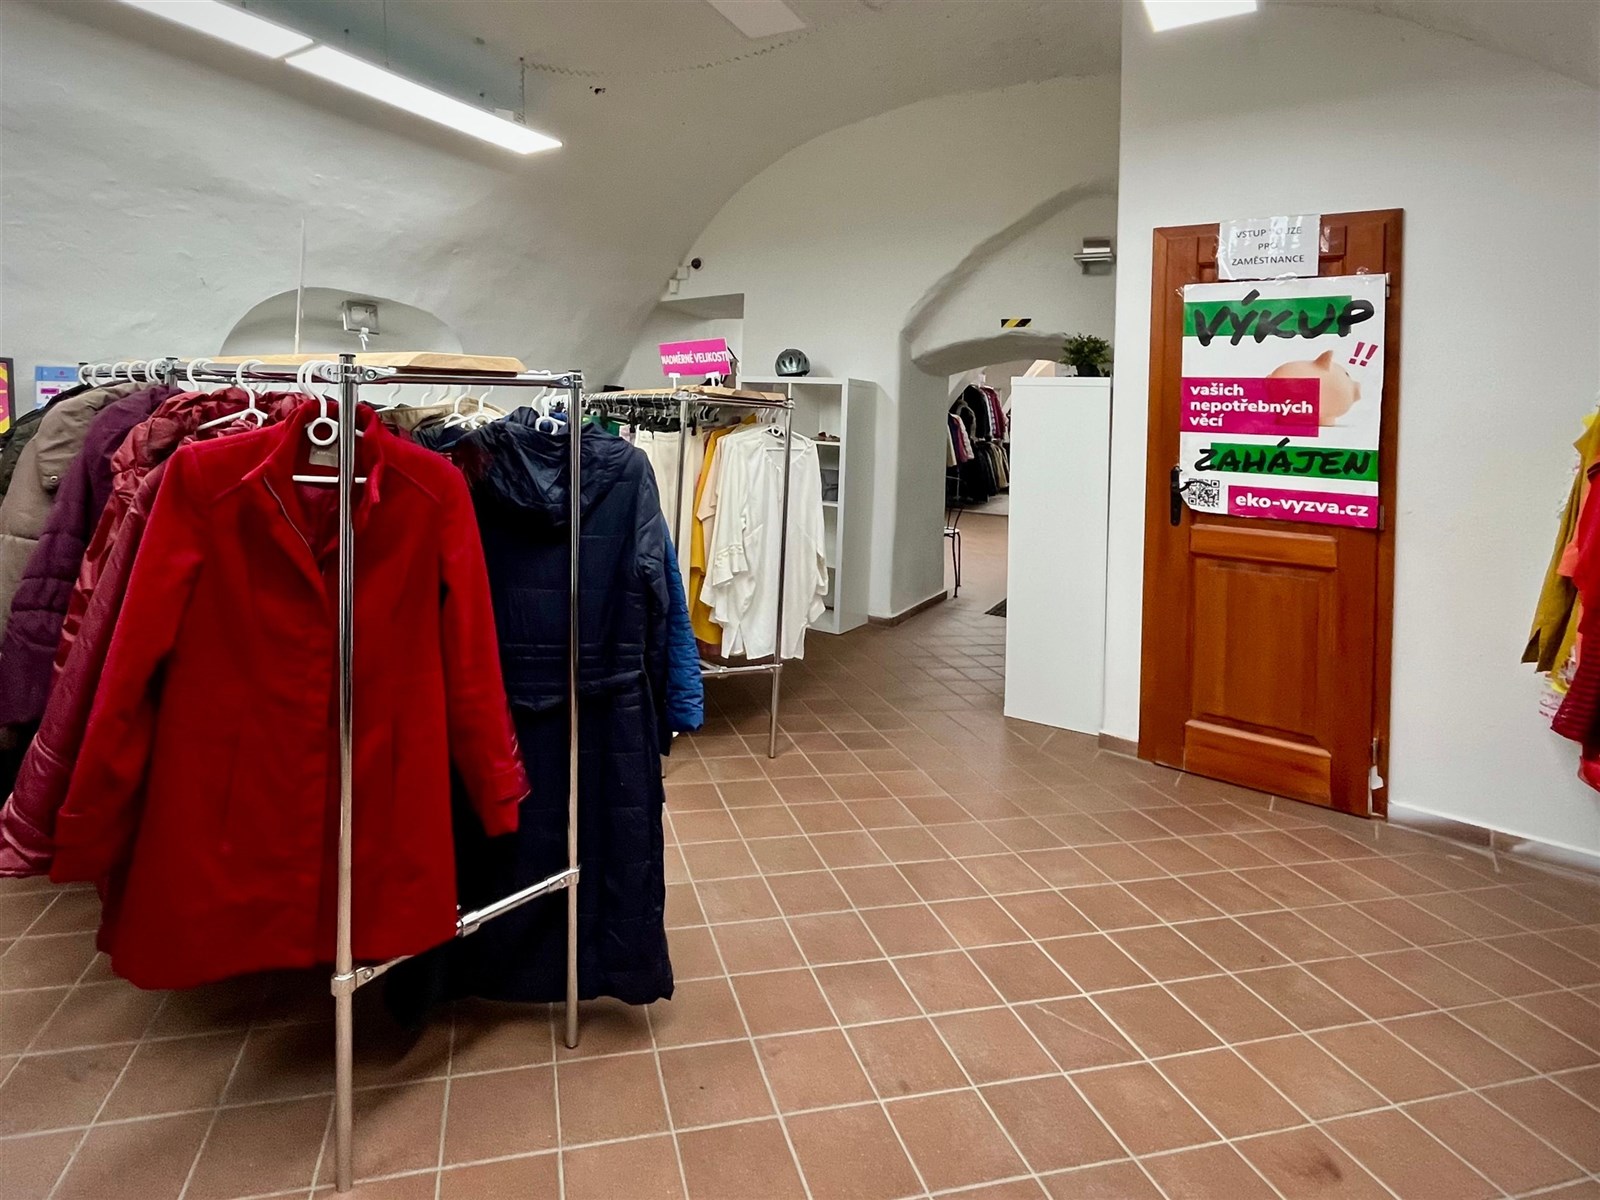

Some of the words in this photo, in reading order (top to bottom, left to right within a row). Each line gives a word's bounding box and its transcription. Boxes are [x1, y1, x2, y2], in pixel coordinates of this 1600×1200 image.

[1236, 229, 1267, 239] VSTUP
[1231, 255, 1305, 266] ZAMĚSTNANCE
[1194, 289, 1375, 346] VÝKUP
[1190, 382, 1244, 397] vašich
[1190, 400, 1313, 416] nepotřebných
[1189, 414, 1224, 427] věcí
[1194, 437, 1371, 475] ZAHÁJEN
[1235, 493, 1369, 517] eko-vyzva.cz
